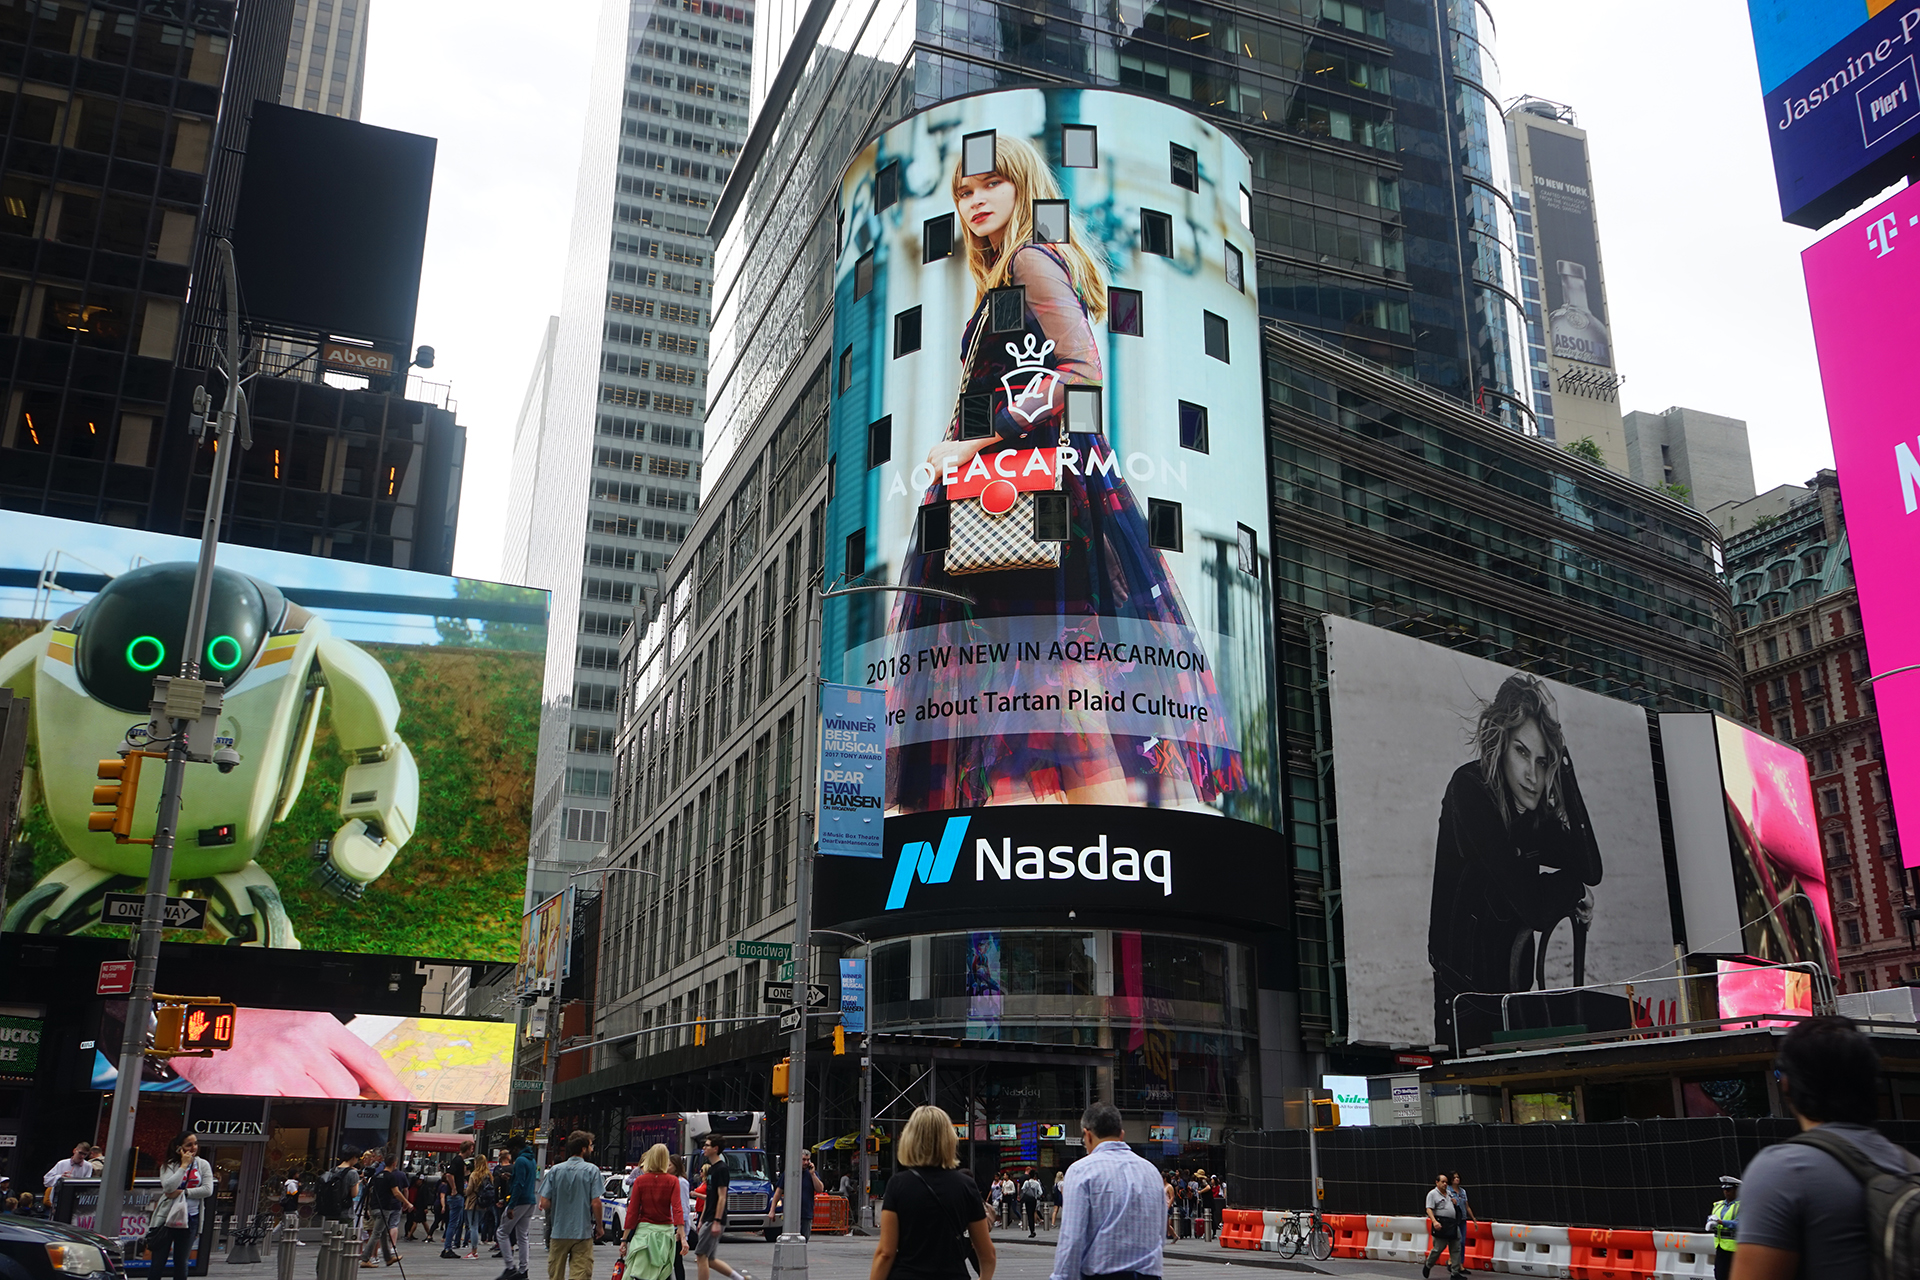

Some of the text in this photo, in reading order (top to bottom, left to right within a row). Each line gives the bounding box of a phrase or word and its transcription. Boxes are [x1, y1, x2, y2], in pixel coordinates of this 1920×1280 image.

[1533, 175, 1545, 186] TO
[1546, 178, 1564, 191] NEW
[328, 349, 388, 369] Absen
[866, 641, 1206, 685] 2018 FW NEW IN AQEACARMON
[915, 696, 978, 721] about
[983, 690, 1060, 713] Tartan
[1068, 689, 1126, 712] Plaid
[1132, 692, 1209, 723] Culture
[825, 719, 876, 733] WINNER
[825, 729, 859, 742] BEST
[825, 741, 882, 755] MUSICAL
[823, 769, 864, 785] DEAR
[823, 781, 861, 796] EVAN
[823, 793, 881, 809] HANSEN
[822, 838, 879, 847] DearEvanHansen.com
[975, 834, 1172, 897] Nasdaq
[118, 903, 144, 916] ONE
[740, 943, 790, 960] Broadway
[773, 988, 819, 1000] ONE AY
[214, 1015, 231, 1041] 10
[513, 1081, 542, 1089] BROADWAY
[1002, 1086, 1041, 1098] Nasdaq
[193, 1120, 264, 1135] CITIZEN
